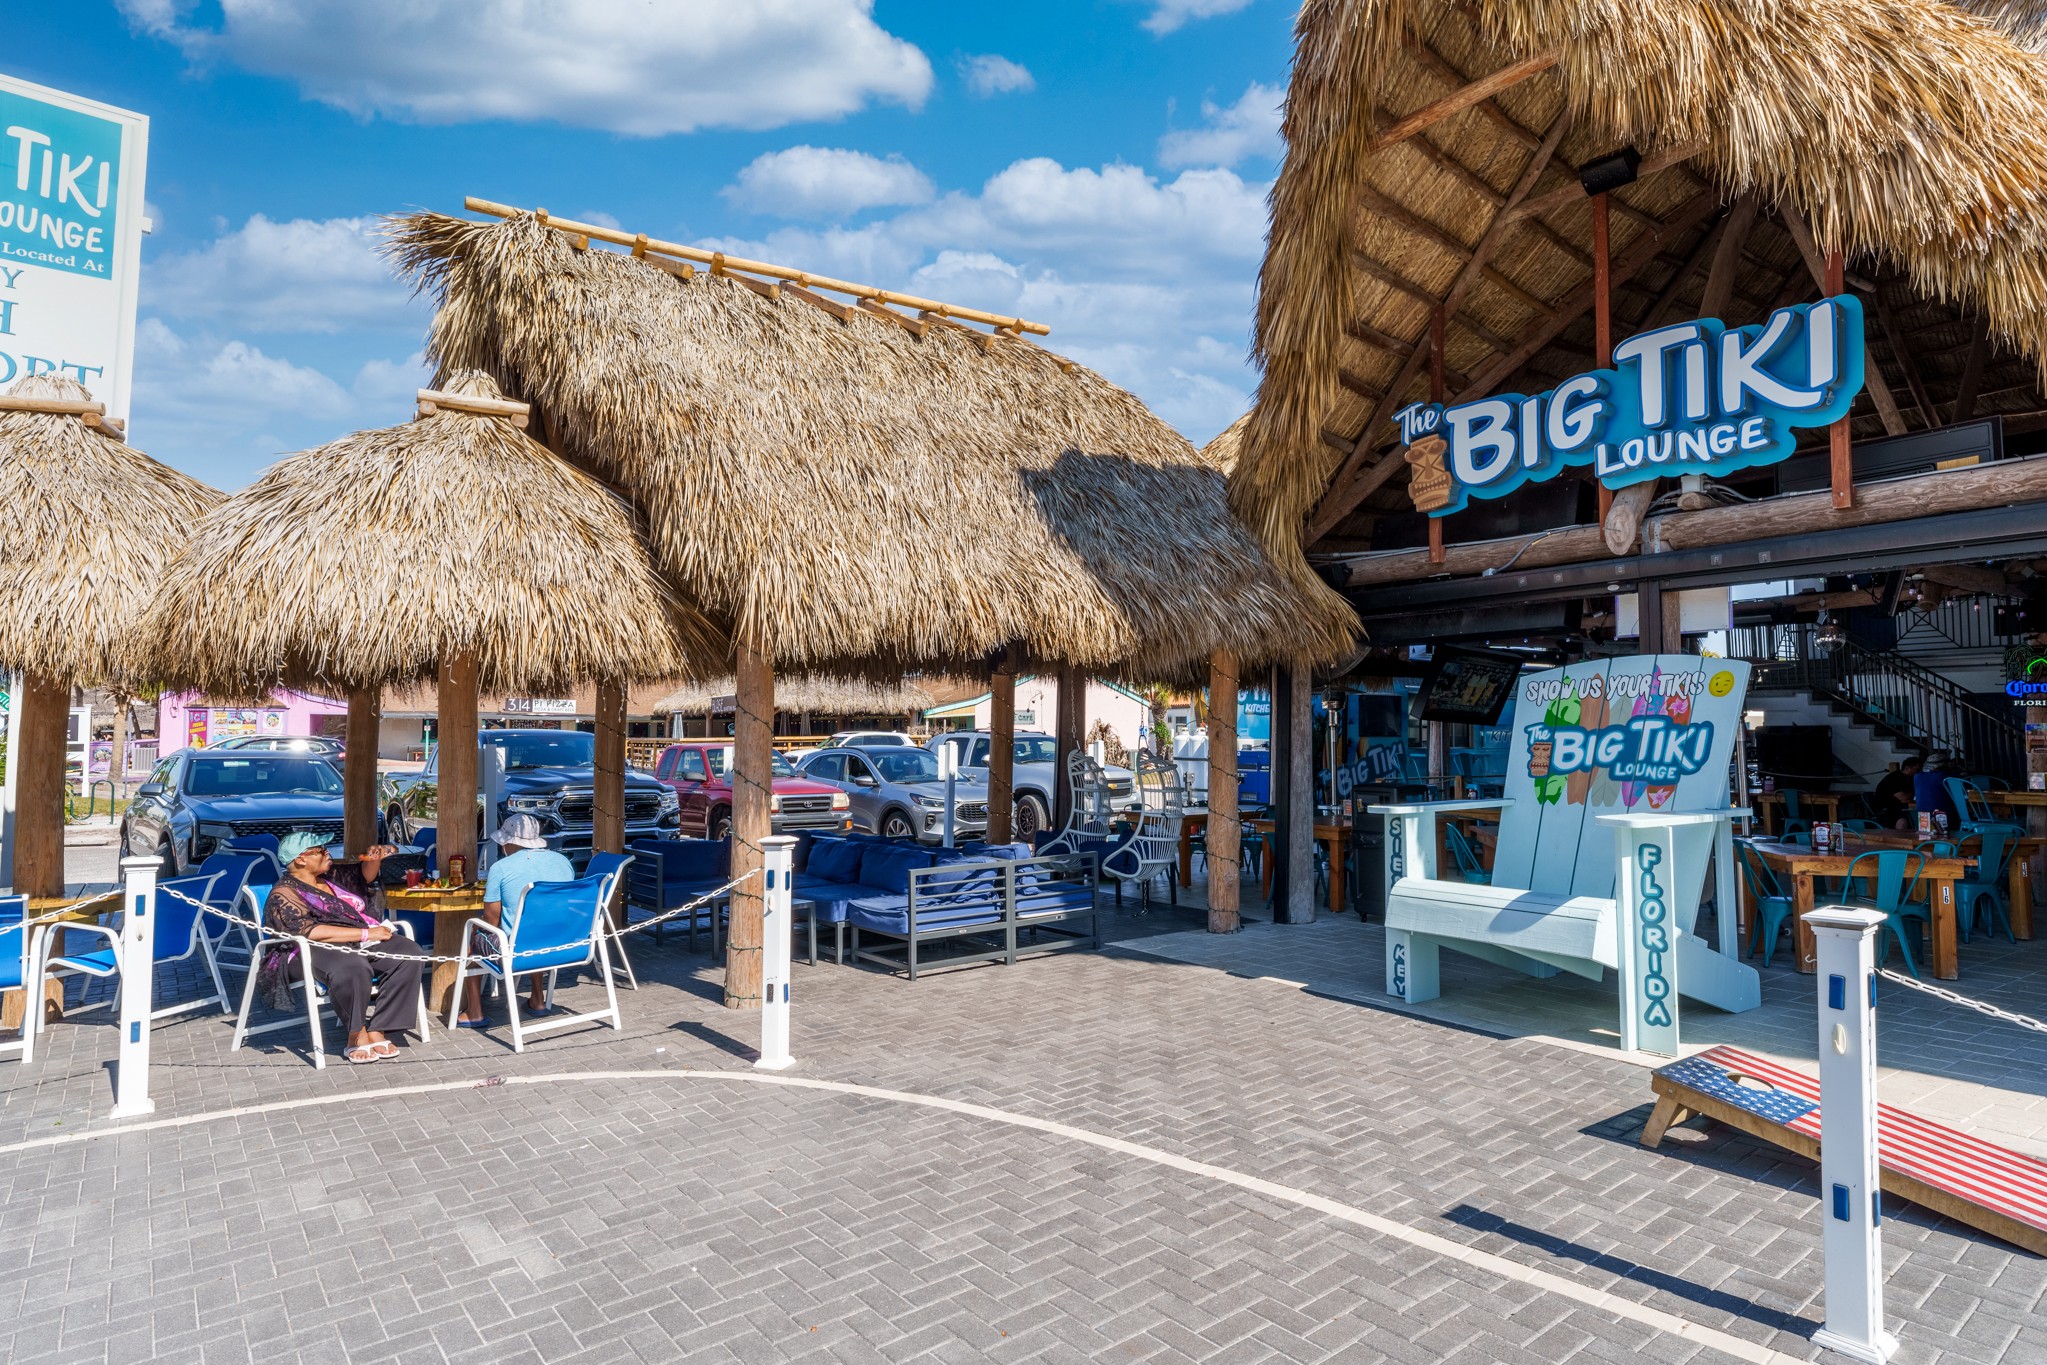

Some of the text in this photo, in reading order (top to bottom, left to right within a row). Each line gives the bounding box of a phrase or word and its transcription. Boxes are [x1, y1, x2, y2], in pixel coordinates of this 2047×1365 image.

[7, 125, 110, 217] TIKI
[0, 201, 104, 253] OUNGE
[3, 241, 105, 273] Located At
[1392, 299, 1838, 485] The BIG TIKI
[1596, 416, 1771, 478] LOUNGE
[508, 697, 531, 711] 3.14
[1526, 679, 1576, 707] SHOW
[1578, 677, 1602, 699] US
[1606, 674, 1654, 704] YOUR
[1657, 671, 1707, 699] TIKIS
[2006, 679, 2047, 698] Coro
[1245, 703, 1270, 713] KITCHE
[1528, 720, 1710, 771] The BIG TIKI
[1336, 760, 1369, 797] BIG
[1614, 763, 1678, 779] LOUNGE
[1640, 846, 1670, 1025] FLORIDA
